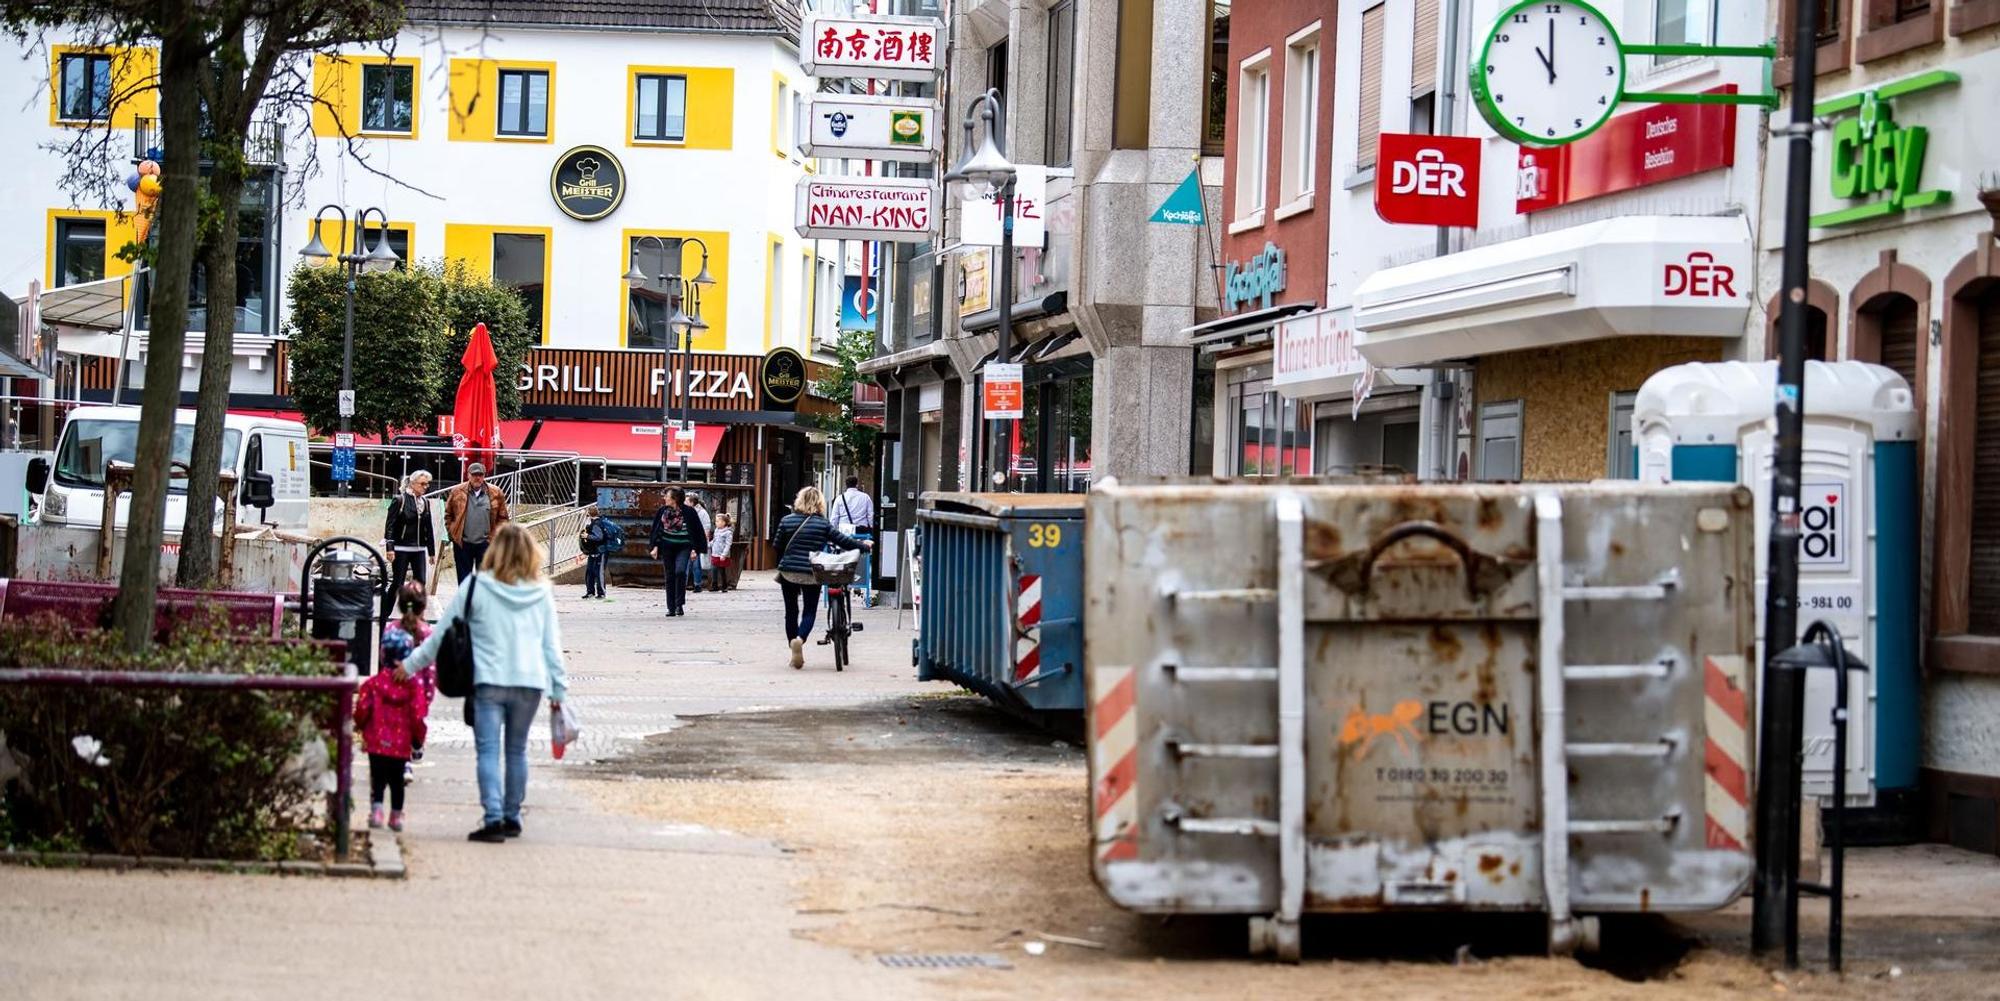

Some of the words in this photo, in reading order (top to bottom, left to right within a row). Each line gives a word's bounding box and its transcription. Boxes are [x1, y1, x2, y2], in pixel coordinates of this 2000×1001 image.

[1546, 5, 1561, 14] 12
[1514, 15, 1528, 23] 11
[1580, 17, 1586, 26] 1
[817, 27, 933, 63] 南京酒樓
[1495, 34, 1509, 43] 10
[1597, 37, 1606, 45] 2
[1487, 65, 1494, 74] 9
[1606, 66, 1614, 76] 3
[1495, 94, 1503, 103] 8
[1598, 96, 1606, 105] 4
[1516, 117, 1524, 127] 7
[1574, 119, 1582, 128] 5
[1645, 116, 1677, 139] Deutsches
[1547, 128, 1555, 136] 6
[1831, 92, 1923, 206] City
[1644, 147, 1675, 170] Reisebüro
[579, 179, 596, 187] Grill
[1392, 160, 1466, 197] DER
[562, 186, 613, 197] MEISTER
[811, 185, 927, 201] Chinarestaurant
[810, 203, 927, 229] NAN-KING
[1162, 209, 1201, 223] Kochlöffel
[1225, 241, 1287, 312] Kochlöffel
[1664, 264, 1736, 297] DER
[515, 364, 613, 393] GRILL
[651, 368, 754, 400] PIZZA
[1799, 495, 1837, 531] oi
[1028, 523, 1061, 548] 39
[1799, 532, 1837, 558] oi
[1811, 596, 1833, 609] 981
[1837, 596, 1852, 609] 00
[1428, 701, 1508, 735] EGN
